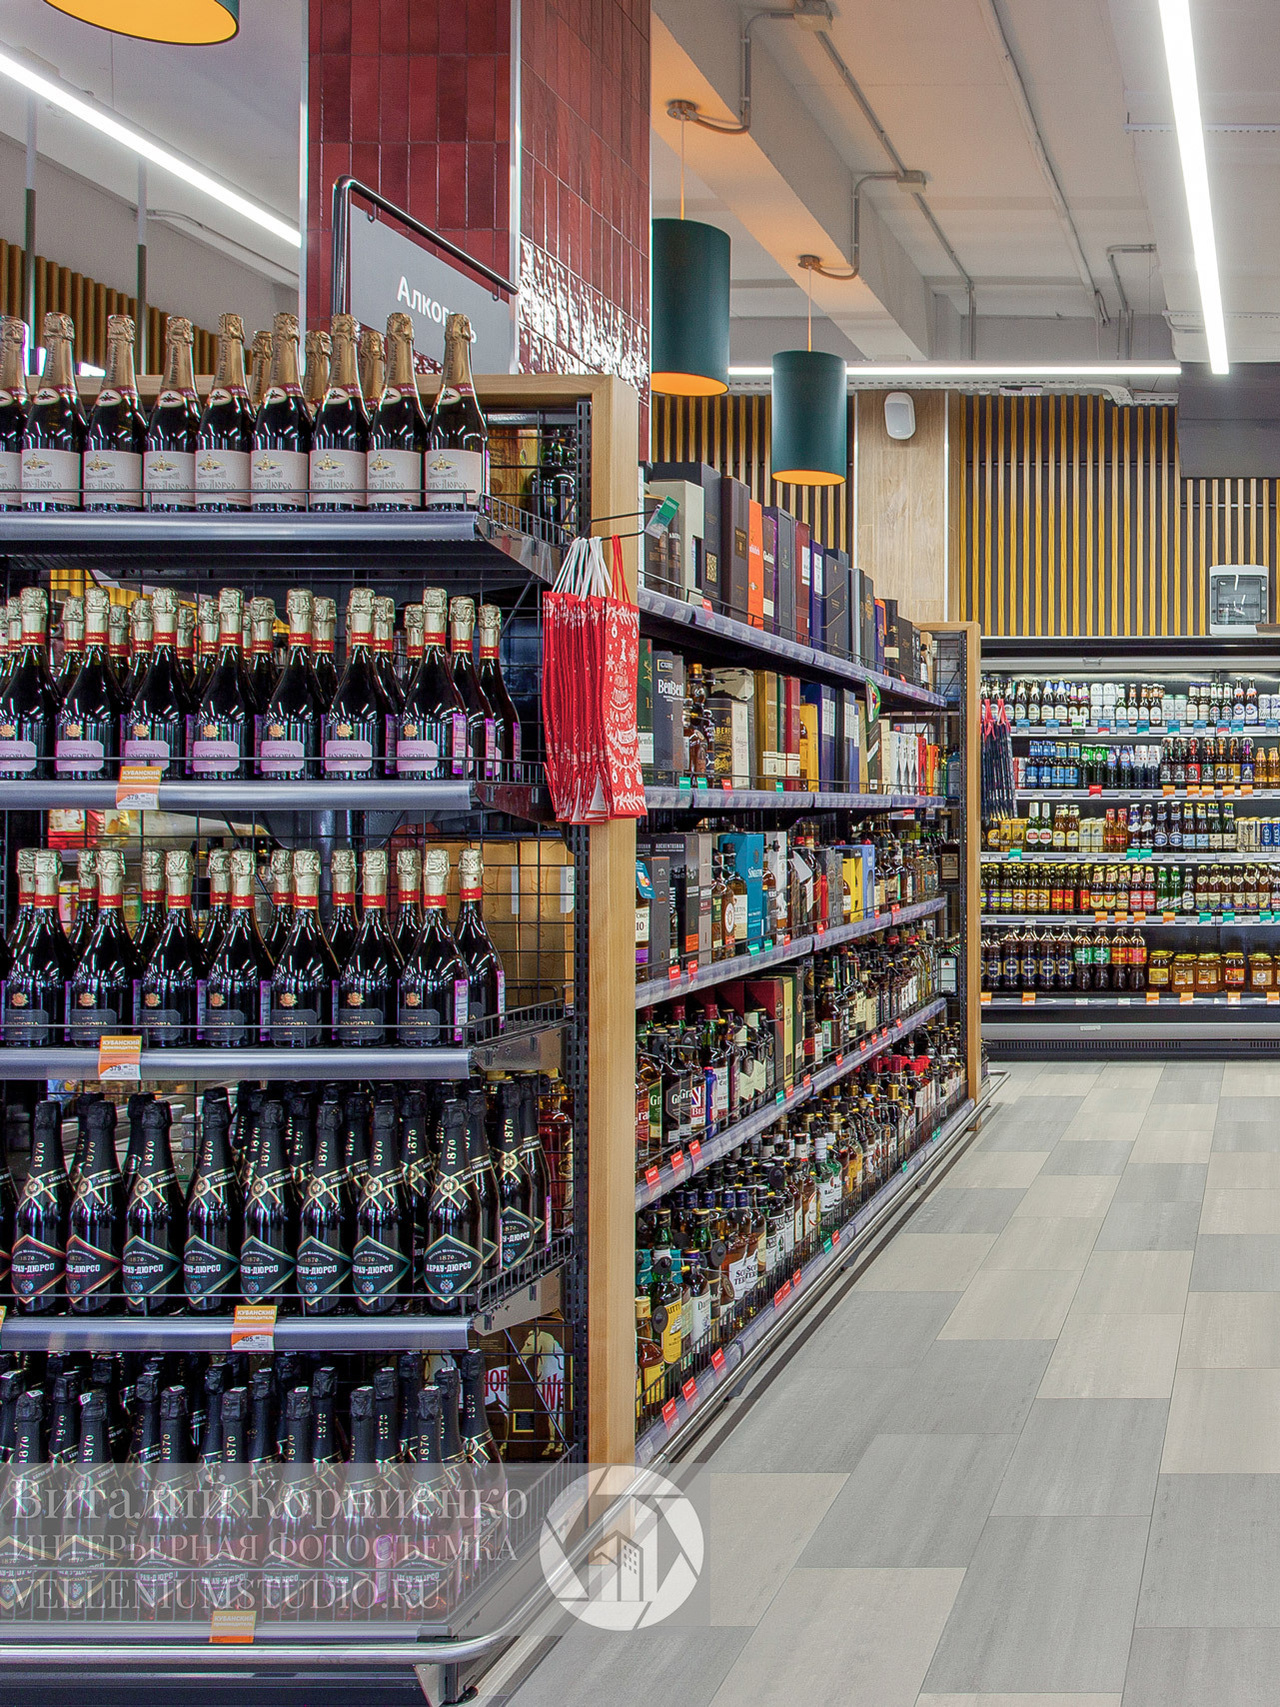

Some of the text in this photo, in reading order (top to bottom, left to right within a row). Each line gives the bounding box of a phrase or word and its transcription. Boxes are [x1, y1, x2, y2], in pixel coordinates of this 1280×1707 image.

[397, 275, 477, 344] Алкогь
[144, 1140, 155, 1167] 1870
[203, 1140, 214, 1167] 1870
[260, 1141, 271, 1167] 1870
[318, 1140, 328, 1167] 1870
[373, 1140, 383, 1167] 1870
[446, 1139, 457, 1165] 1870
[426, 1261, 472, 1273] АБРАУ-ДЮРСО
[162, 1433, 171, 1461] 1870
[226, 1435, 237, 1463] 1870
[287, 1434, 296, 1461] 1870
[420, 1434, 429, 1461] 1870
[214, 1614, 254, 1622] КУБАНСКИЙ
